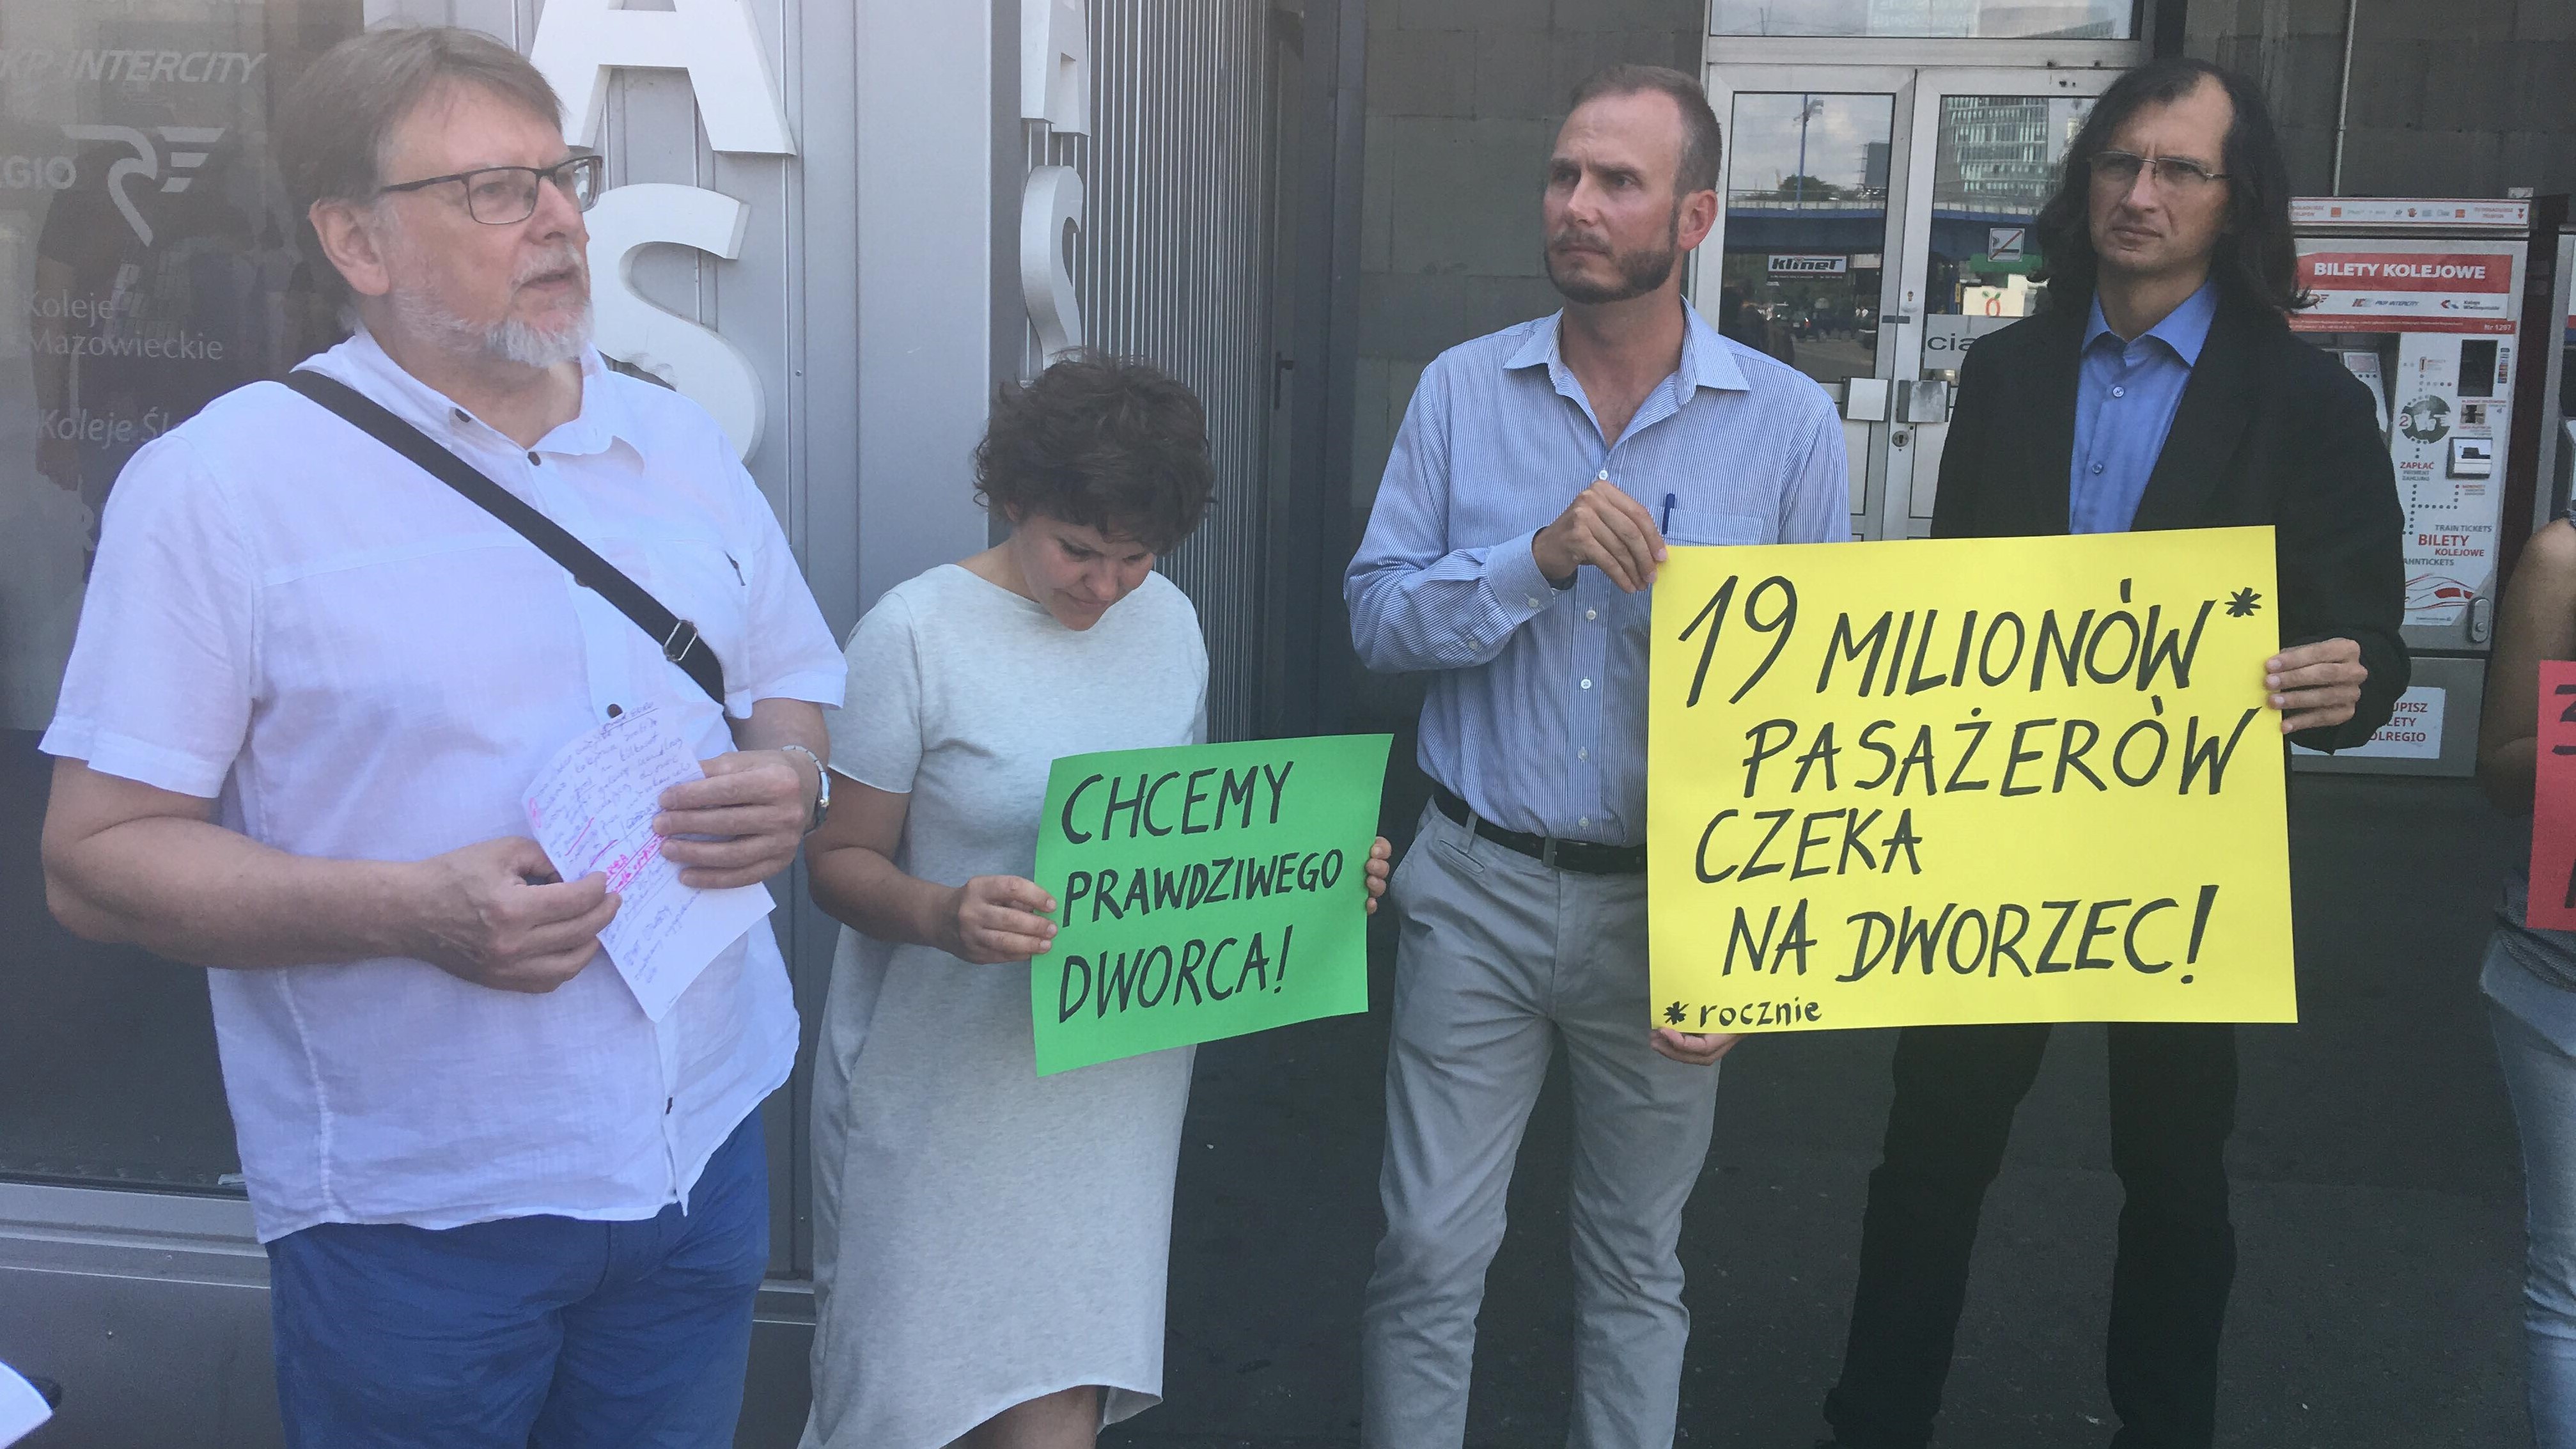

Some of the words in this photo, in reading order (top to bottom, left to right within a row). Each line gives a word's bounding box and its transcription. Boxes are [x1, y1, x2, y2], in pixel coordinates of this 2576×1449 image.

[0, 49, 54, 77] KP
[67, 49, 268, 84] INTERCITY
[2314, 262, 2380, 277] BILETY
[2383, 263, 2486, 279] KOLEJOWE
[24, 288, 114, 328] Koleje
[31, 329, 223, 360] Mazowieckie
[38, 408, 132, 450] Koleje
[141, 406, 170, 443] Śl
[2399, 415, 2409, 427] 2
[2417, 533, 2470, 547] BILETY
[2435, 524, 2459, 532] TRAIN
[2460, 524, 2492, 533] TICKETS
[2405, 557, 2455, 566] AHNTICKETS
[2434, 548, 2485, 557] KOLEJOWE
[1678, 575, 1798, 708] 19
[2387, 717, 2417, 727] ETY
[2393, 702, 2428, 712] UPISZ
[1742, 694, 2263, 799] PASAŻERÓW
[2370, 731, 2426, 742] OLREGIO
[1061, 761, 1294, 844] CHCEMY
[1694, 808, 1923, 884] CZEKA
[1062, 849, 1343, 928] PRAWDZIWEGO
[1722, 898, 1818, 977] NA
[1835, 884, 2220, 985] DWORZEC!
[1059, 924, 1293, 1023] DWORCA!
